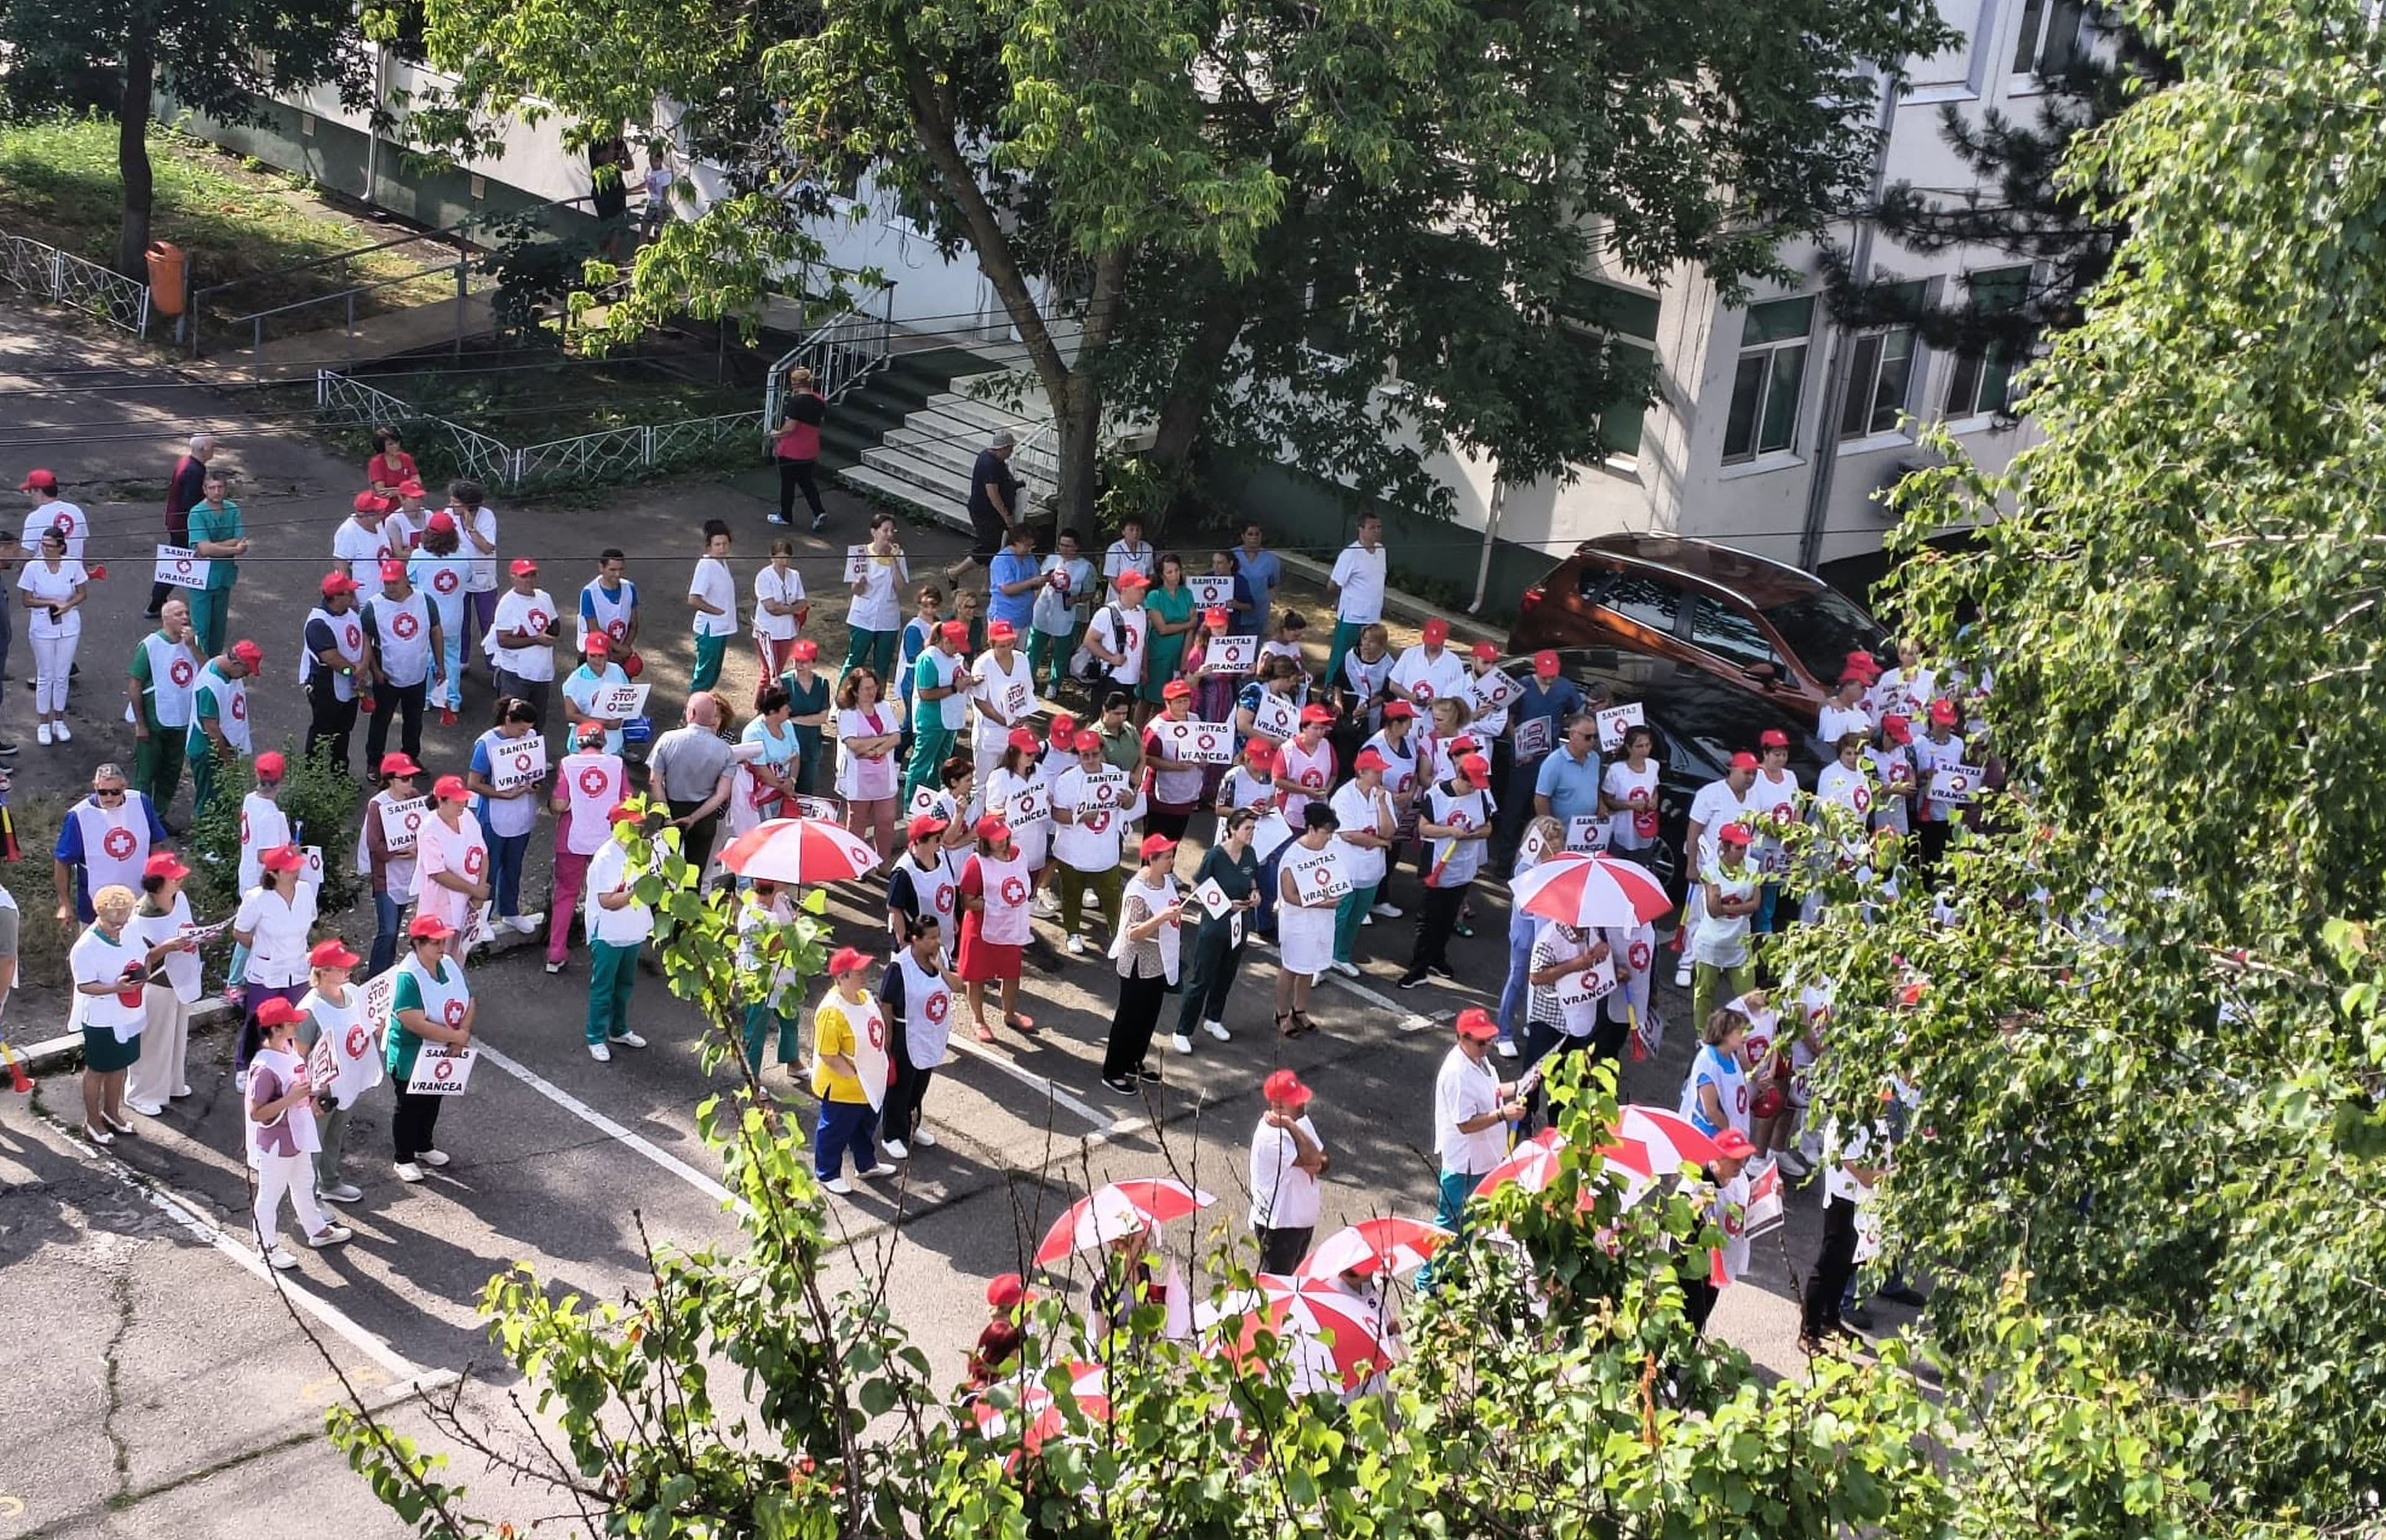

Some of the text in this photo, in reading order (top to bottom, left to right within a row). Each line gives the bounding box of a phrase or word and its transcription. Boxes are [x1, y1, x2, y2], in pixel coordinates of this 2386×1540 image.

[164, 547, 193, 557] SANIT
[158, 572, 204, 586] VRANCEA
[1494, 672, 1520, 693] SANITAS
[611, 692, 638, 701] STOP
[1602, 706, 1636, 720] SANITAS
[1195, 724, 1228, 733] NITAS
[1258, 719, 1293, 739] VRANCE
[499, 739, 539, 756] SANITAS
[499, 768, 544, 786] VRANCEA
[1942, 764, 1980, 777] SANITAS
[1087, 775, 1123, 784] SANITAS
[1012, 783, 1044, 801] SANITAS
[1932, 789, 1968, 800] VRANC
[388, 800, 424, 816] SANITA
[1009, 808, 1048, 829] VRANCEA
[390, 832, 417, 847] VRAN
[1297, 854, 1336, 872] SANITAS
[1303, 881, 1348, 902] VRANCEA
[368, 983, 389, 1004] STOP
[1563, 980, 1615, 1006] VRANCEA
[426, 1049, 469, 1059] SANAS
[412, 1082, 463, 1091] VRANCEA
